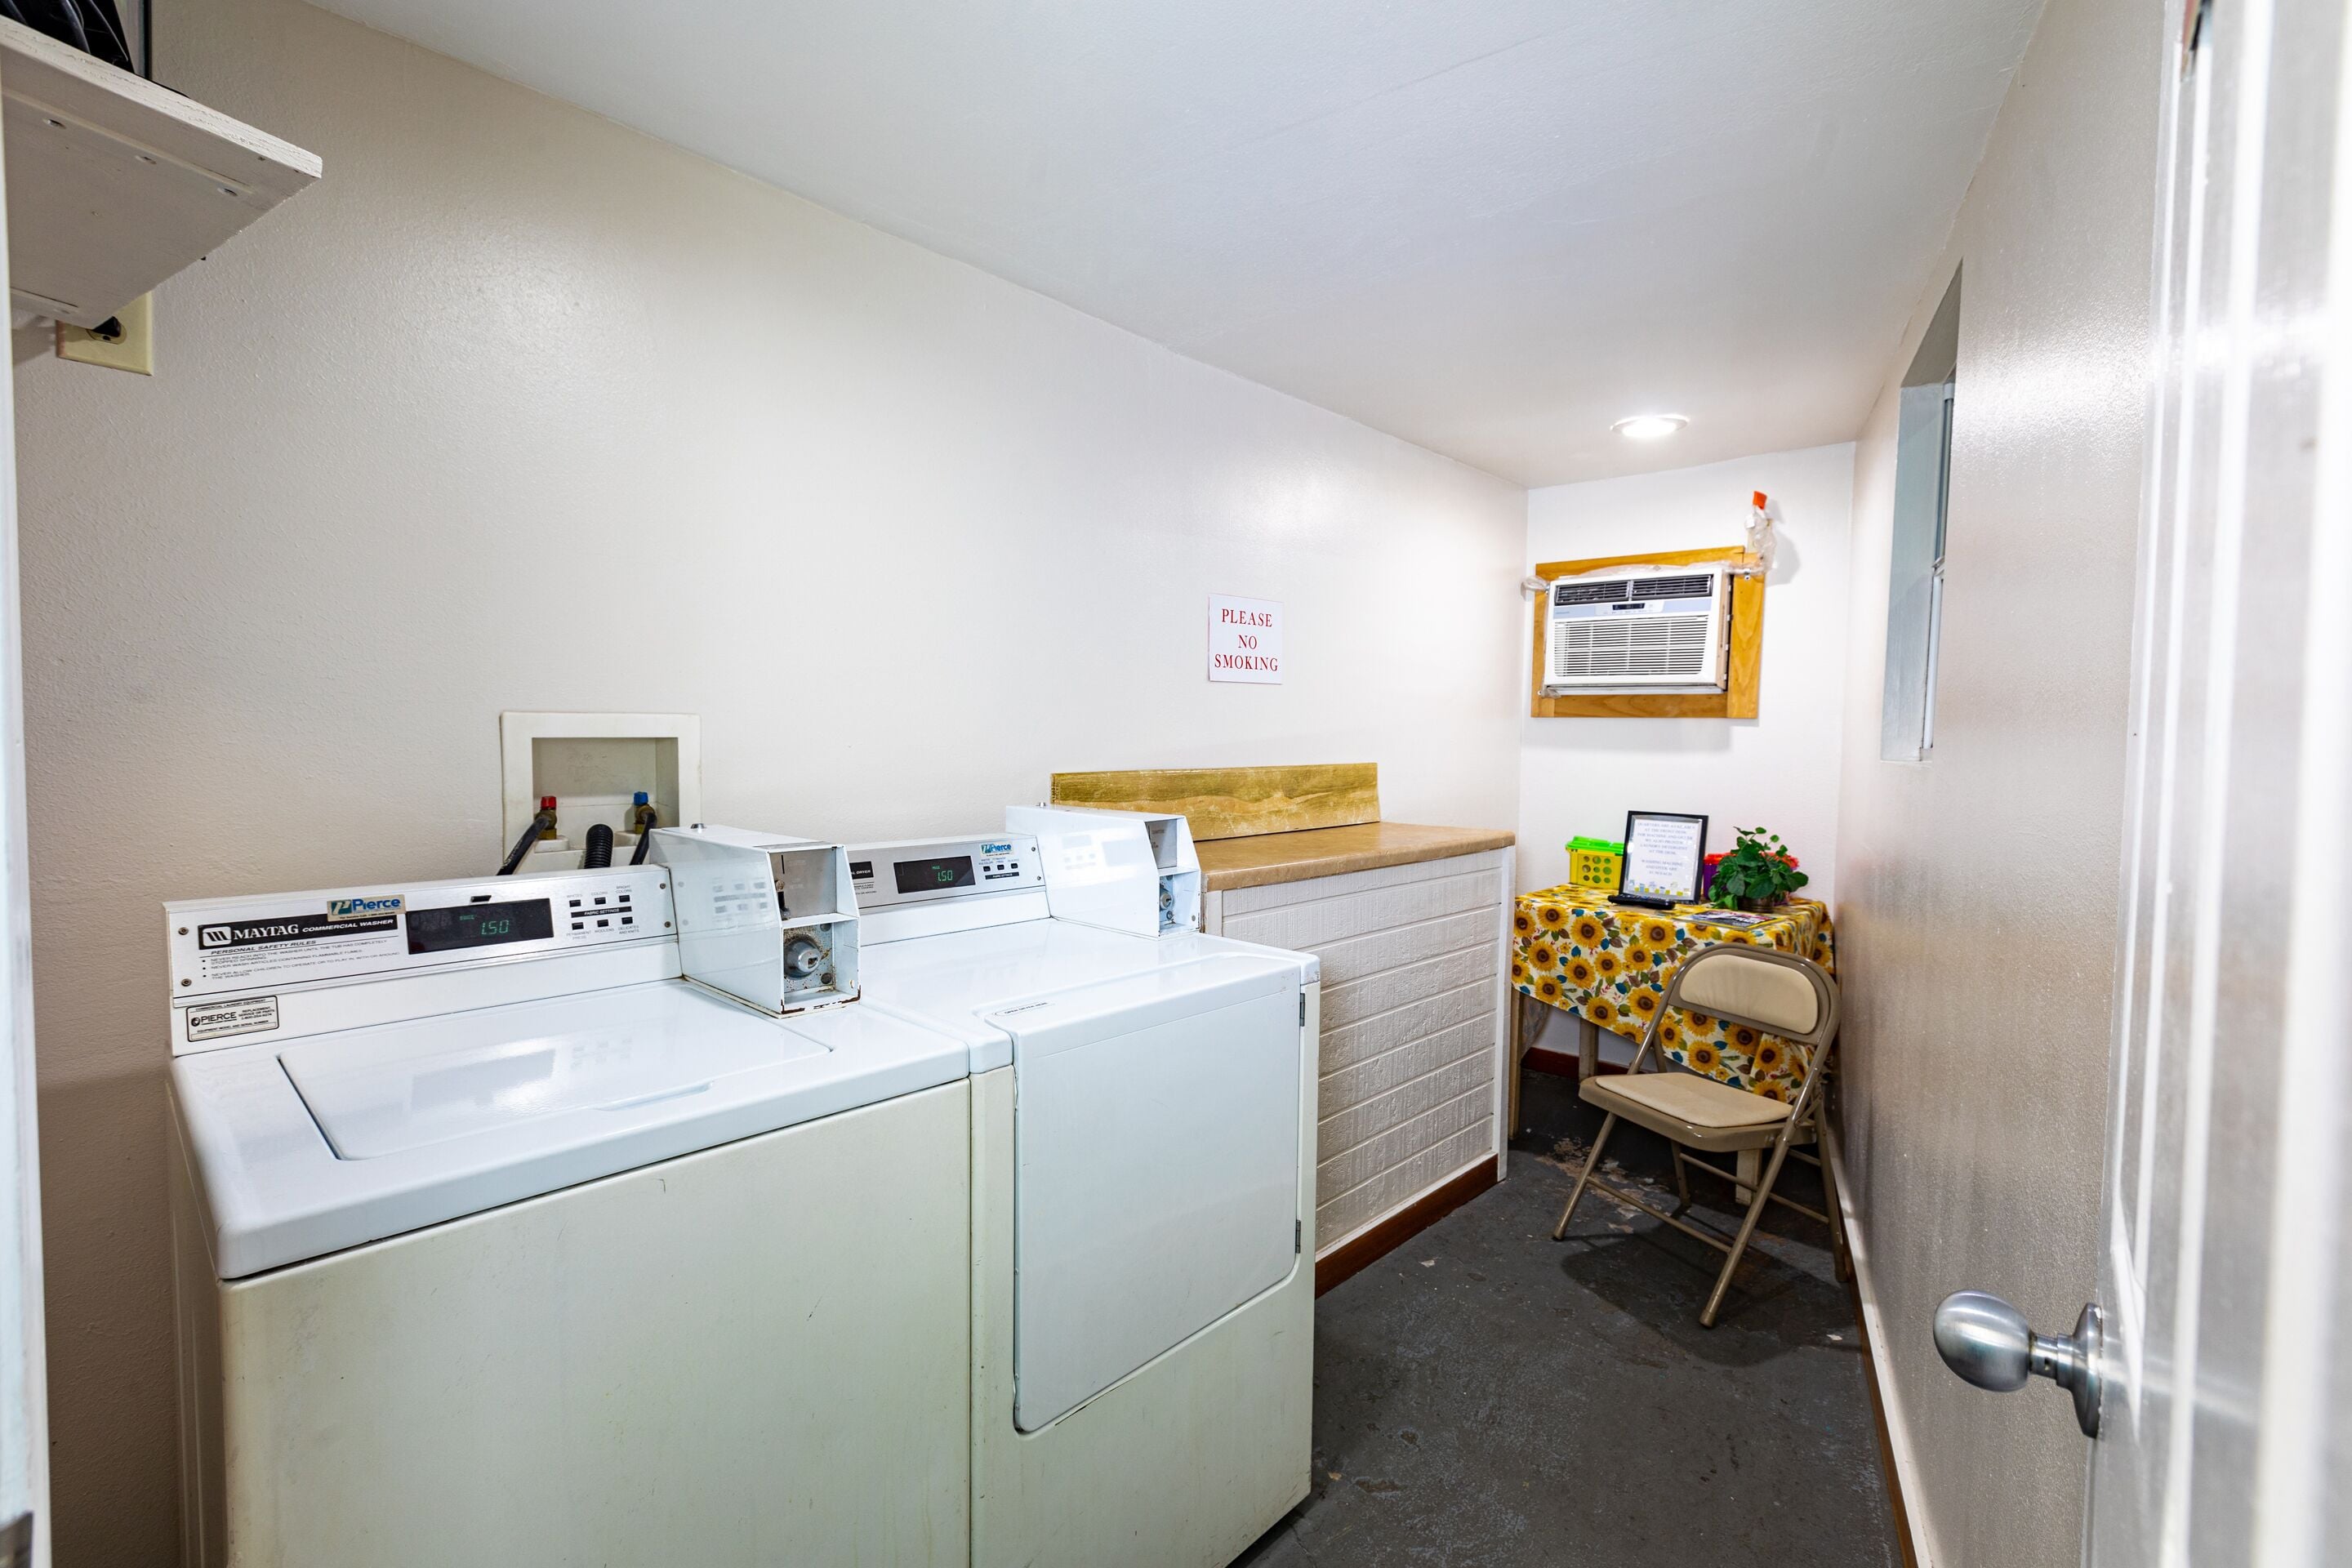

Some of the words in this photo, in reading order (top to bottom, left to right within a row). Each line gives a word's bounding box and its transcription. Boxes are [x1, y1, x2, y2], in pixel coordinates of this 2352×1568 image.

[1222, 608, 1272, 627] PLEASE
[1238, 635, 1257, 649] NO
[1214, 653, 1278, 671] SMOKING
[352, 898, 401, 911] Pierce
[234, 924, 299, 940] MAYTAG
[302, 922, 358, 933] COMMERCIAL
[360, 919, 394, 927] WASHER
[201, 1011, 237, 1022] PIERCE
